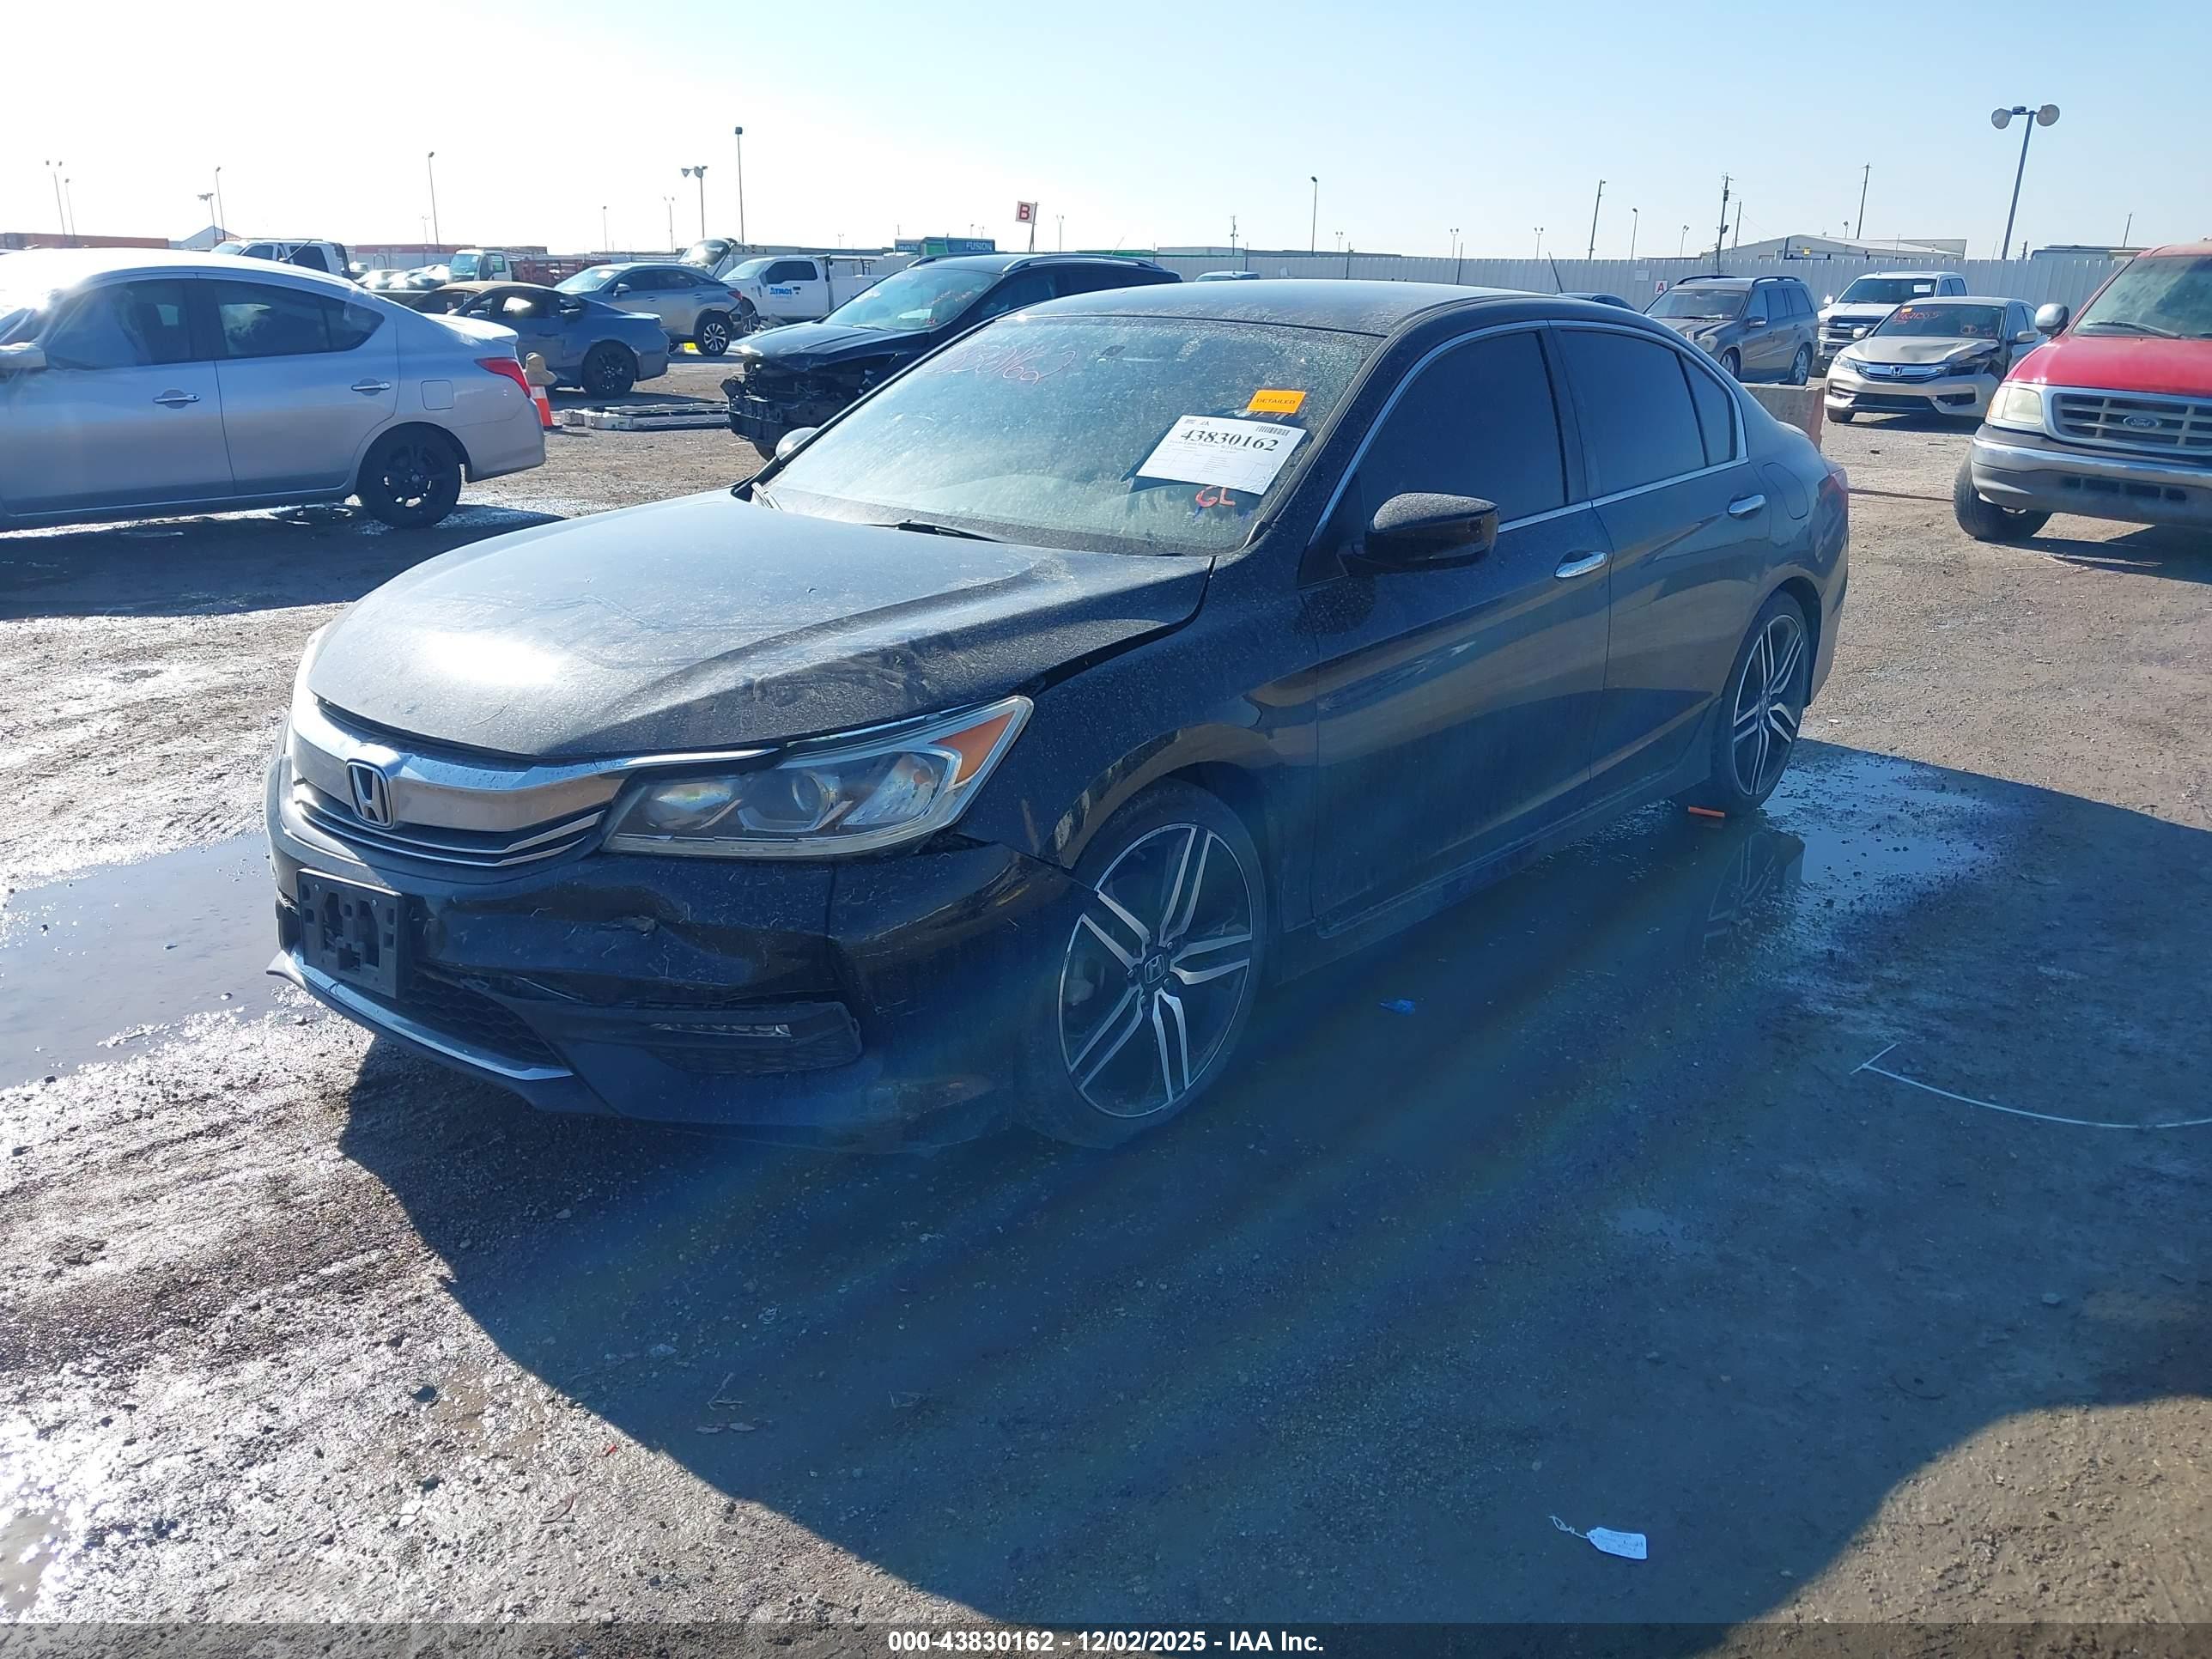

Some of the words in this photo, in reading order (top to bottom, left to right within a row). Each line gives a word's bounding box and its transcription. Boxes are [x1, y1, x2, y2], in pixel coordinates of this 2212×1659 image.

[1019, 204, 1030, 220] B
[1656, 283, 1664, 293] A
[1181, 428, 1279, 452] 43830162
